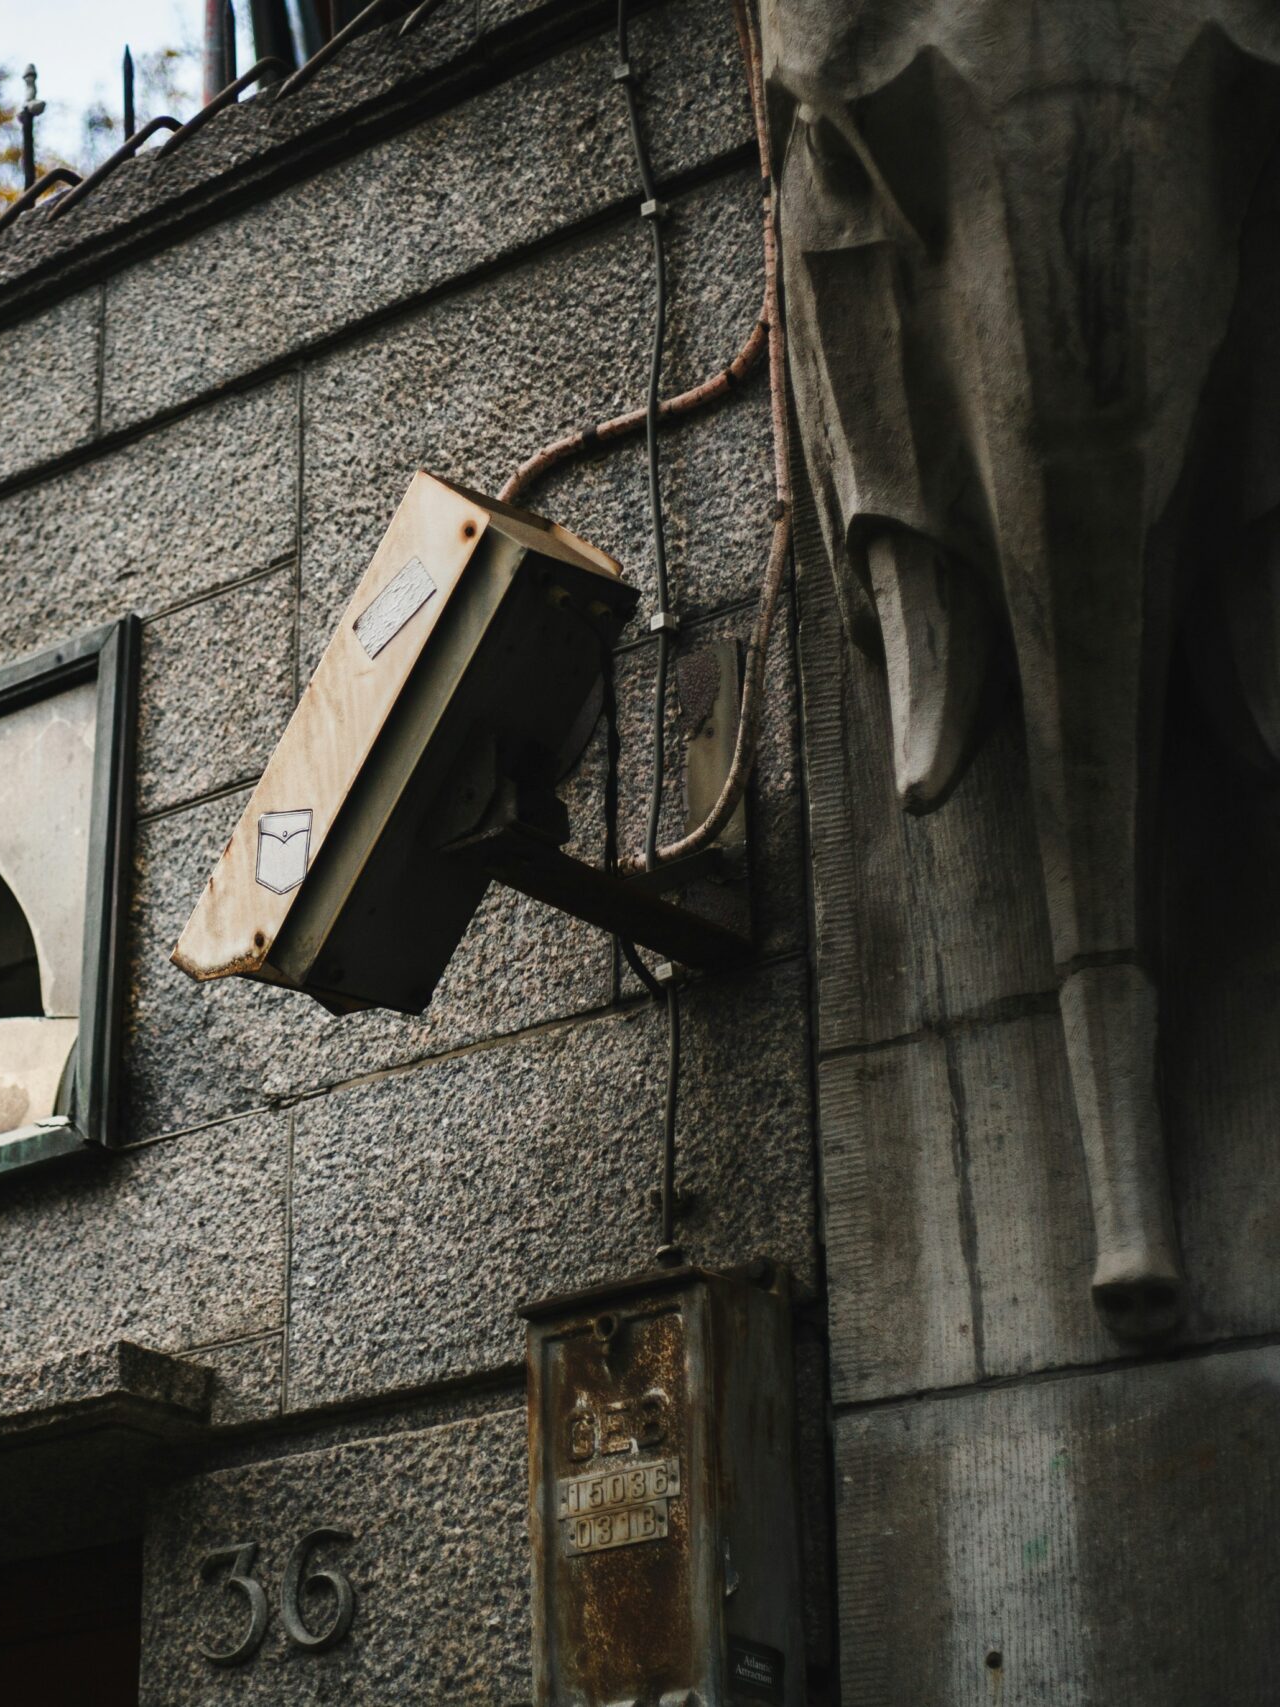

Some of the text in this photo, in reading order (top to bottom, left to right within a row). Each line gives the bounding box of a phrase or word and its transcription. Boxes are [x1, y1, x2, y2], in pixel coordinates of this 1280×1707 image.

[571, 1465, 669, 1512] 15036
[197, 1526, 354, 1663] 36
[736, 1664, 772, 1684] Attraction
